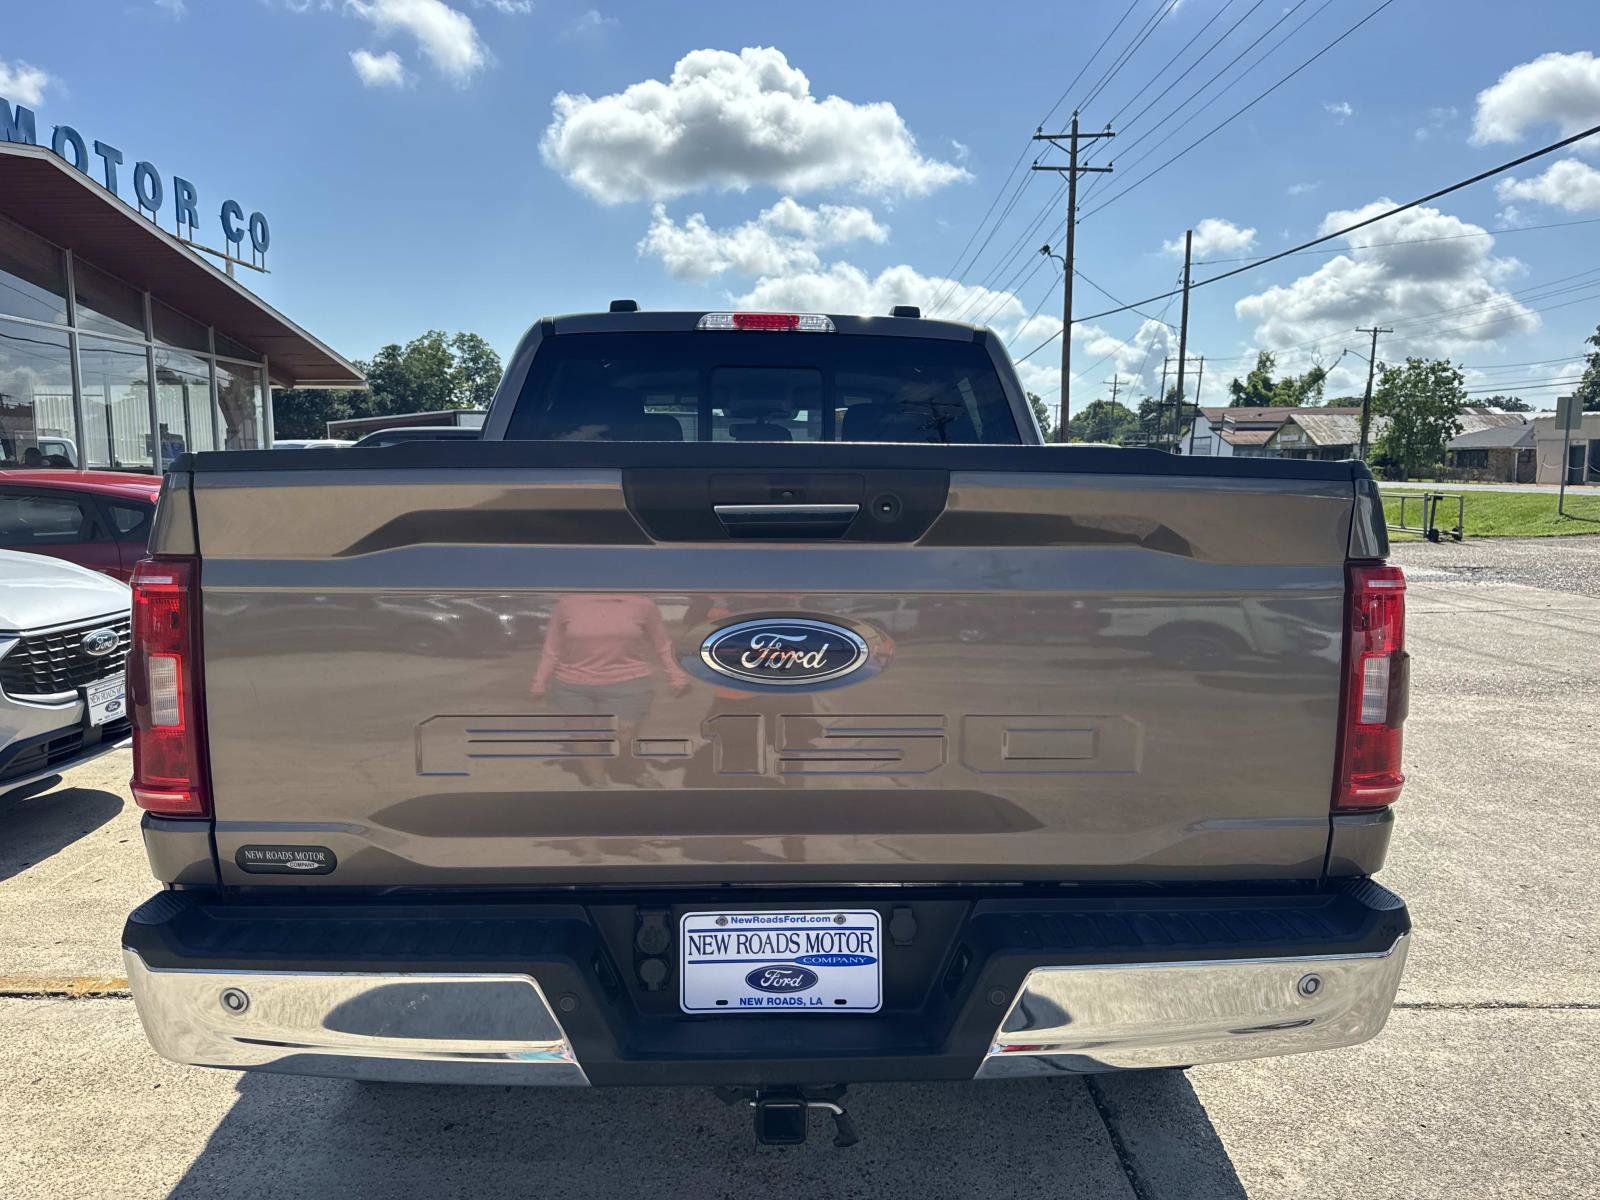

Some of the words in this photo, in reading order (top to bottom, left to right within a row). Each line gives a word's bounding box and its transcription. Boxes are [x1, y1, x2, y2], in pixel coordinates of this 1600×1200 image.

[220, 199, 270, 254] CO
[95, 635, 113, 651] Ford
[741, 632, 830, 669] Ford
[414, 714, 1143, 777] F-150
[245, 850, 264, 859] NEW
[266, 850, 293, 860] ROADS
[295, 852, 325, 861] MOTOR
[731, 915, 831, 924] NewRoadsFord.com
[688, 933, 732, 955] NEW
[736, 932, 801, 955] ROADS
[805, 931, 874, 954] MOTOR
[802, 956, 867, 964] COMPANY
[760, 968, 805, 987] Ford
[739, 997, 765, 1006] NEW
[766, 997, 806, 1007] ROADS,
[809, 997, 823, 1006] LA
